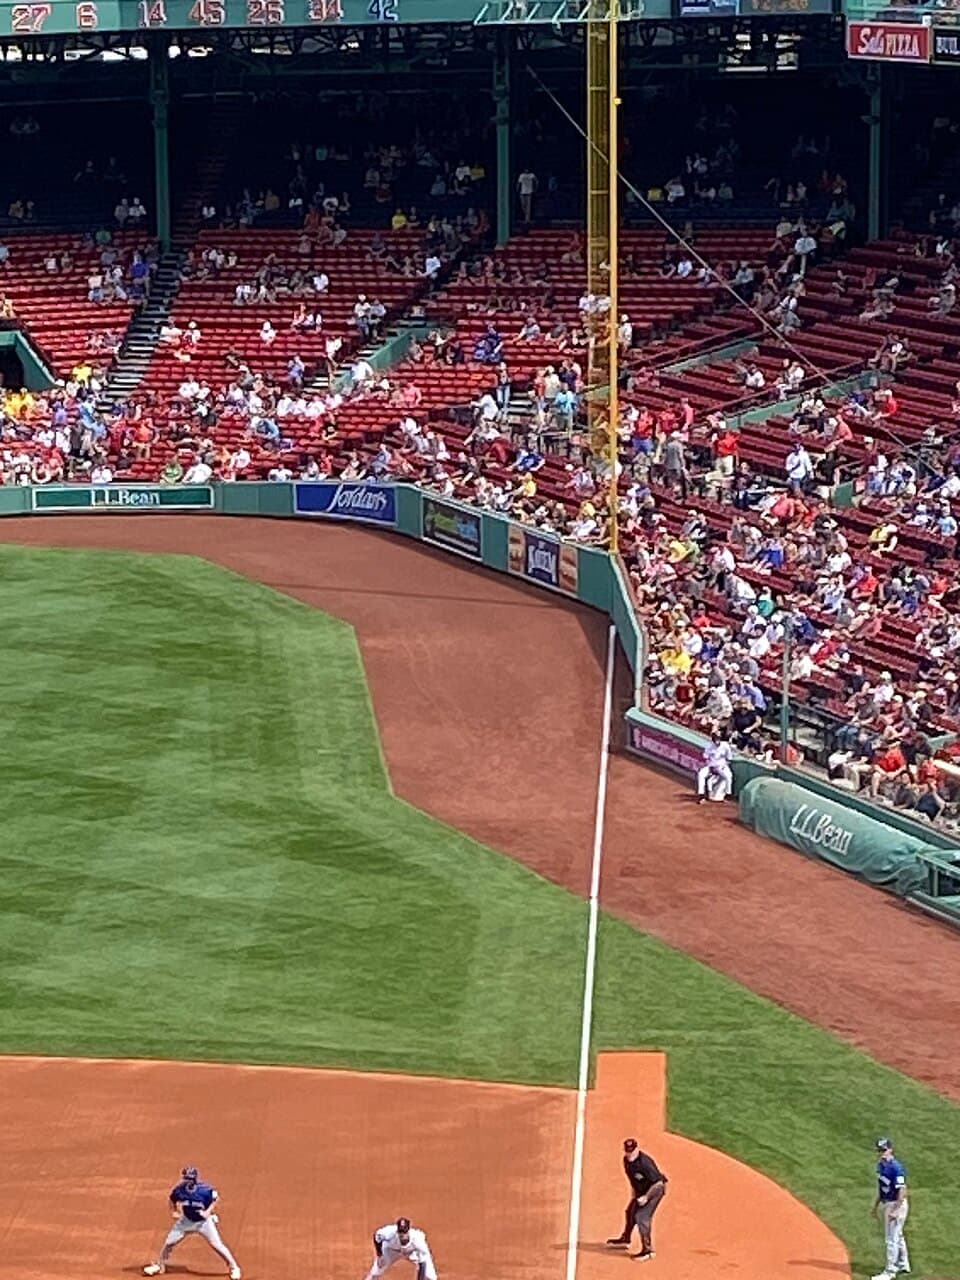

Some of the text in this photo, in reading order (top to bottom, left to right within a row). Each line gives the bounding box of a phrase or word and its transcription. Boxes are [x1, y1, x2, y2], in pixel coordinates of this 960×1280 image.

[11, 4, 51, 32] 27
[77, 3, 98, 31] 6
[139, 0, 167, 27] 14
[189, 0, 225, 26] 45
[246, 0, 285, 26] 26
[308, 0, 343, 22] 34
[367, 0, 398, 21] 42
[885, 33, 920, 56] PIZZA
